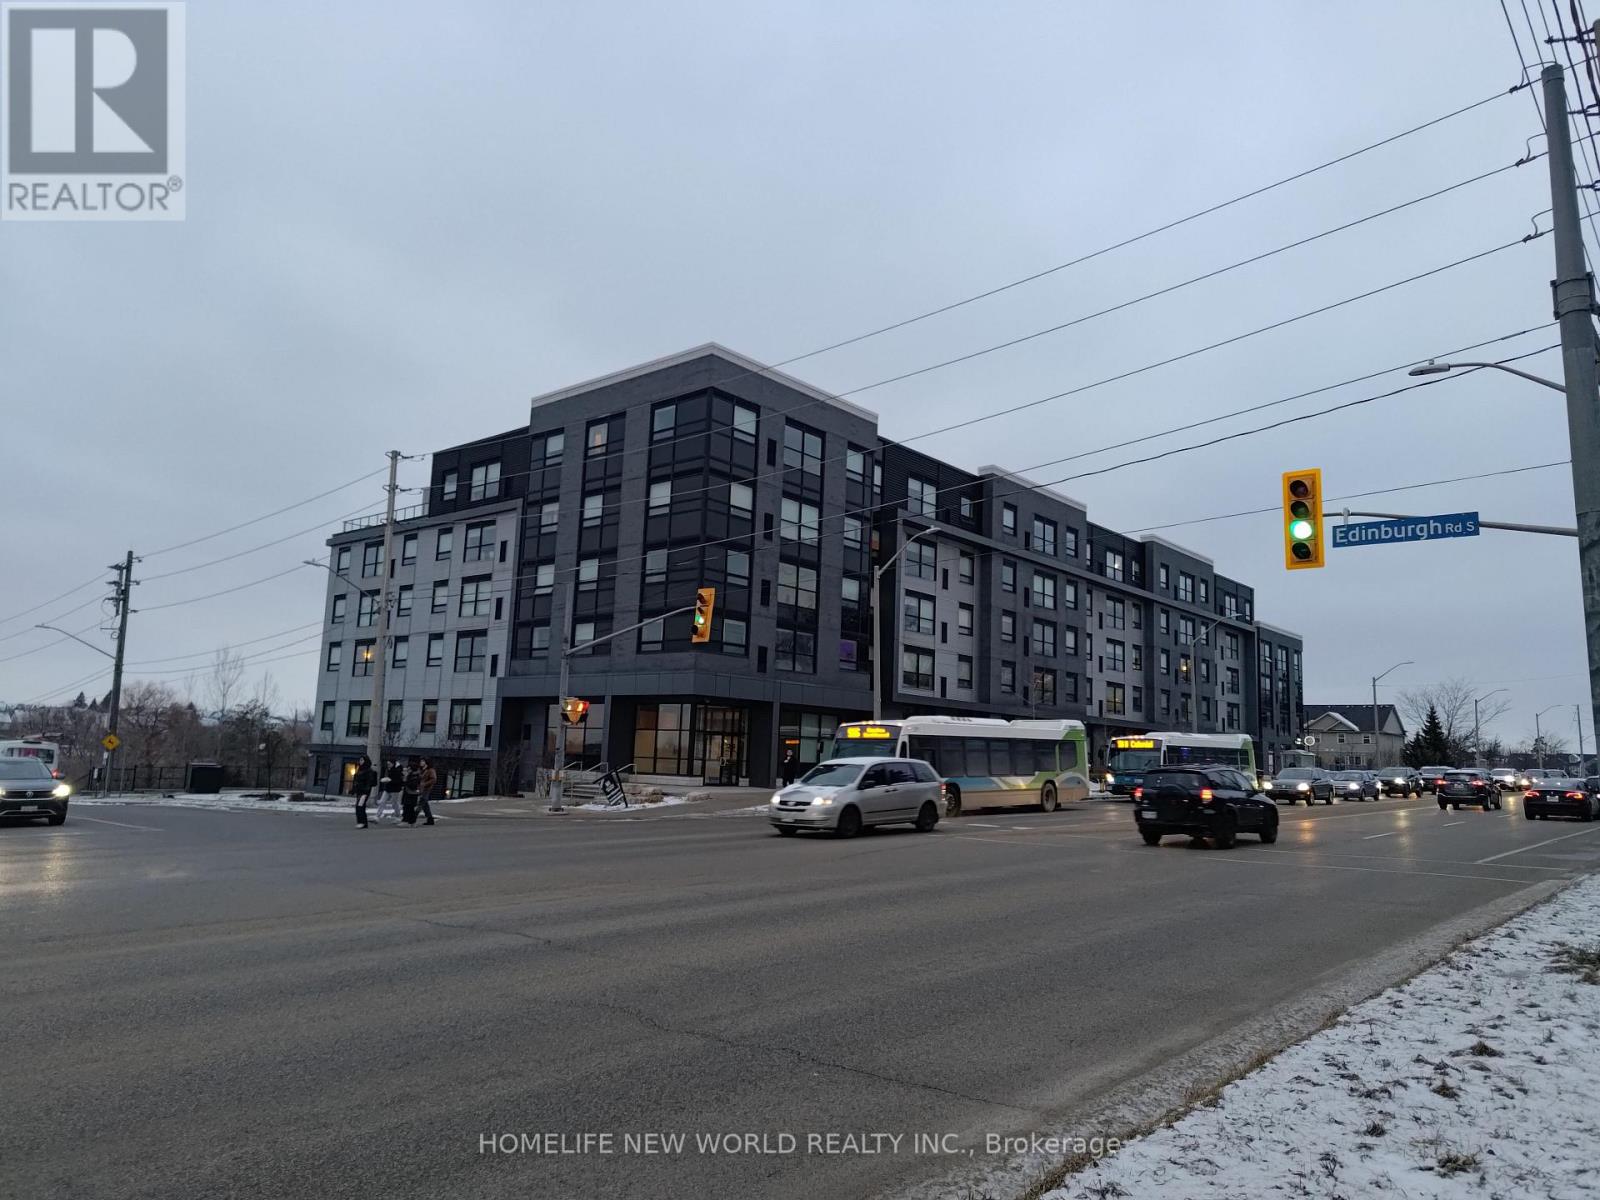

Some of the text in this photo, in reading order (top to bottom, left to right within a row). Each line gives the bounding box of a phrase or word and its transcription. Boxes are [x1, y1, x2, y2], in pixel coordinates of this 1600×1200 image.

[1336, 519, 1475, 543] Edinburgh Rd S
